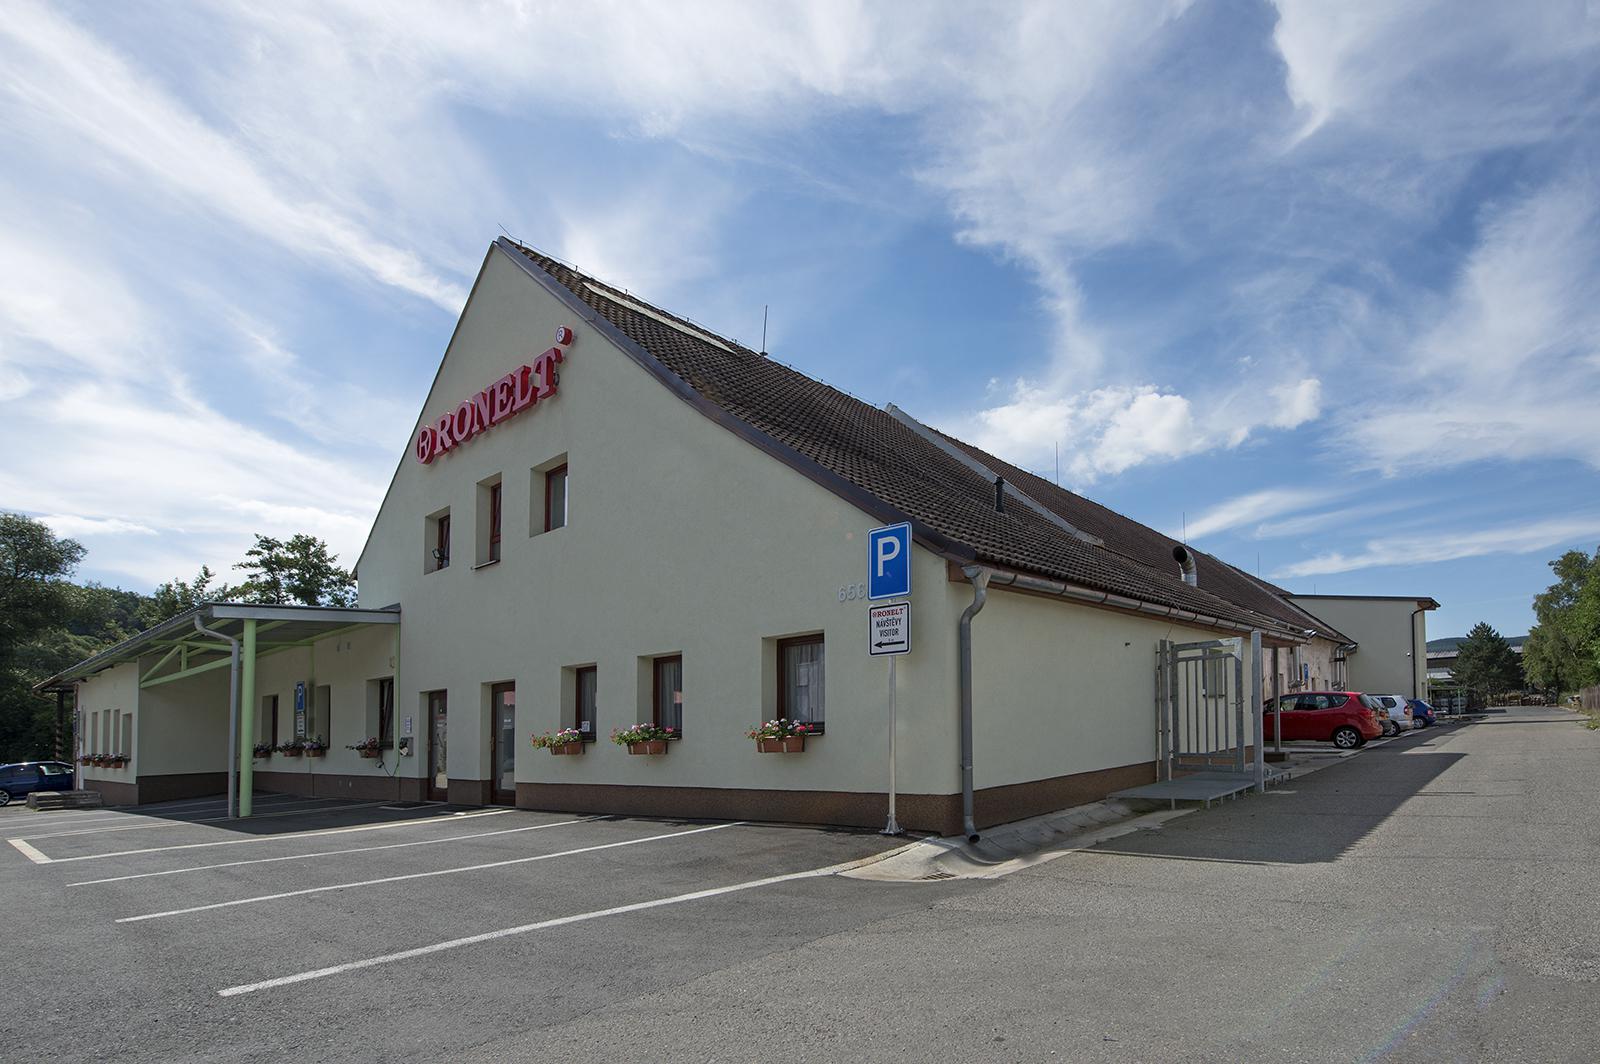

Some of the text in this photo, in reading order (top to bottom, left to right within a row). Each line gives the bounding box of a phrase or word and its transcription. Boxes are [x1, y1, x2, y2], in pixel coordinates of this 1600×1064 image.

[433, 347, 562, 456] RONELT
[878, 536, 900, 577] P
[877, 608, 903, 618] RONELT
[877, 617, 902, 628] NÁVŠTĚVY
[879, 628, 899, 637] VISITOR
